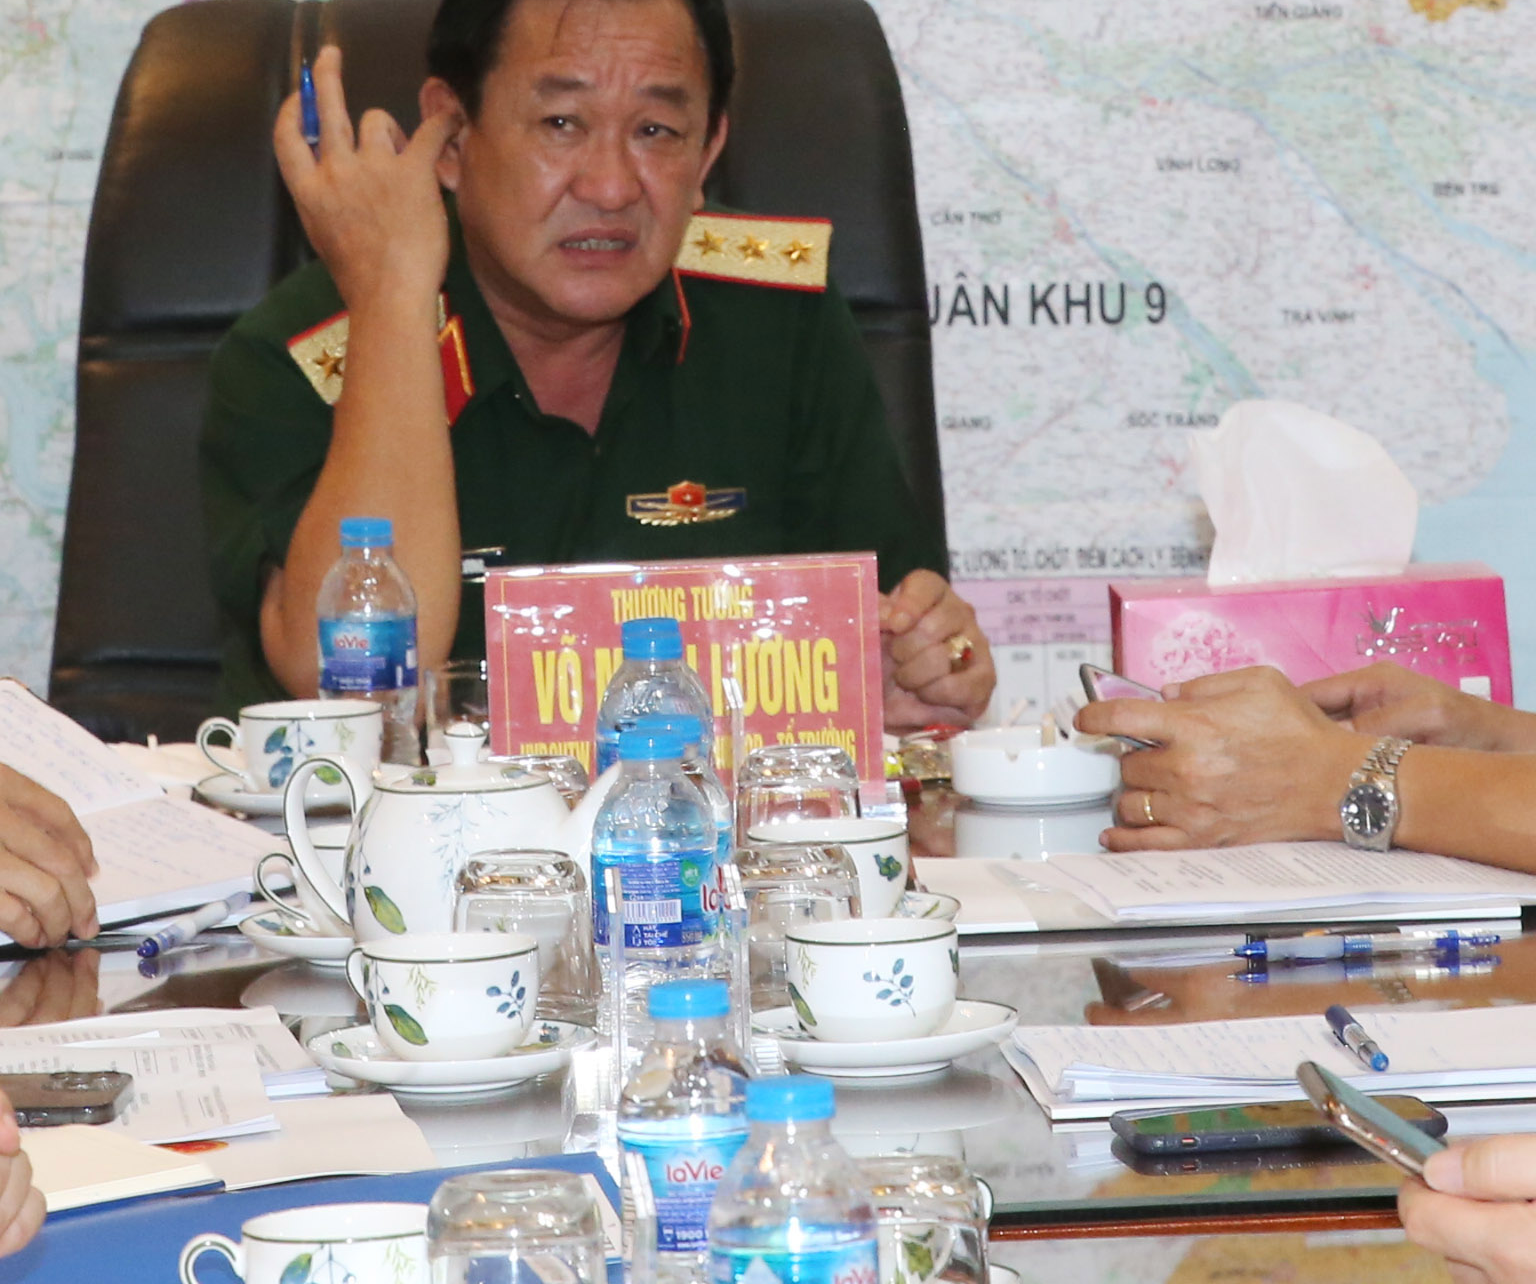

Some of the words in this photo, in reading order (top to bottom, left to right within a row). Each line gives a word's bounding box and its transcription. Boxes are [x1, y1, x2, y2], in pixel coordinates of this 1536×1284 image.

[928, 271, 1009, 327] UÂN
[1031, 281, 1125, 326] KHU
[1145, 281, 1166, 324] 9
[532, 633, 583, 725] VÕ
[666, 1159, 724, 1184] laVie
